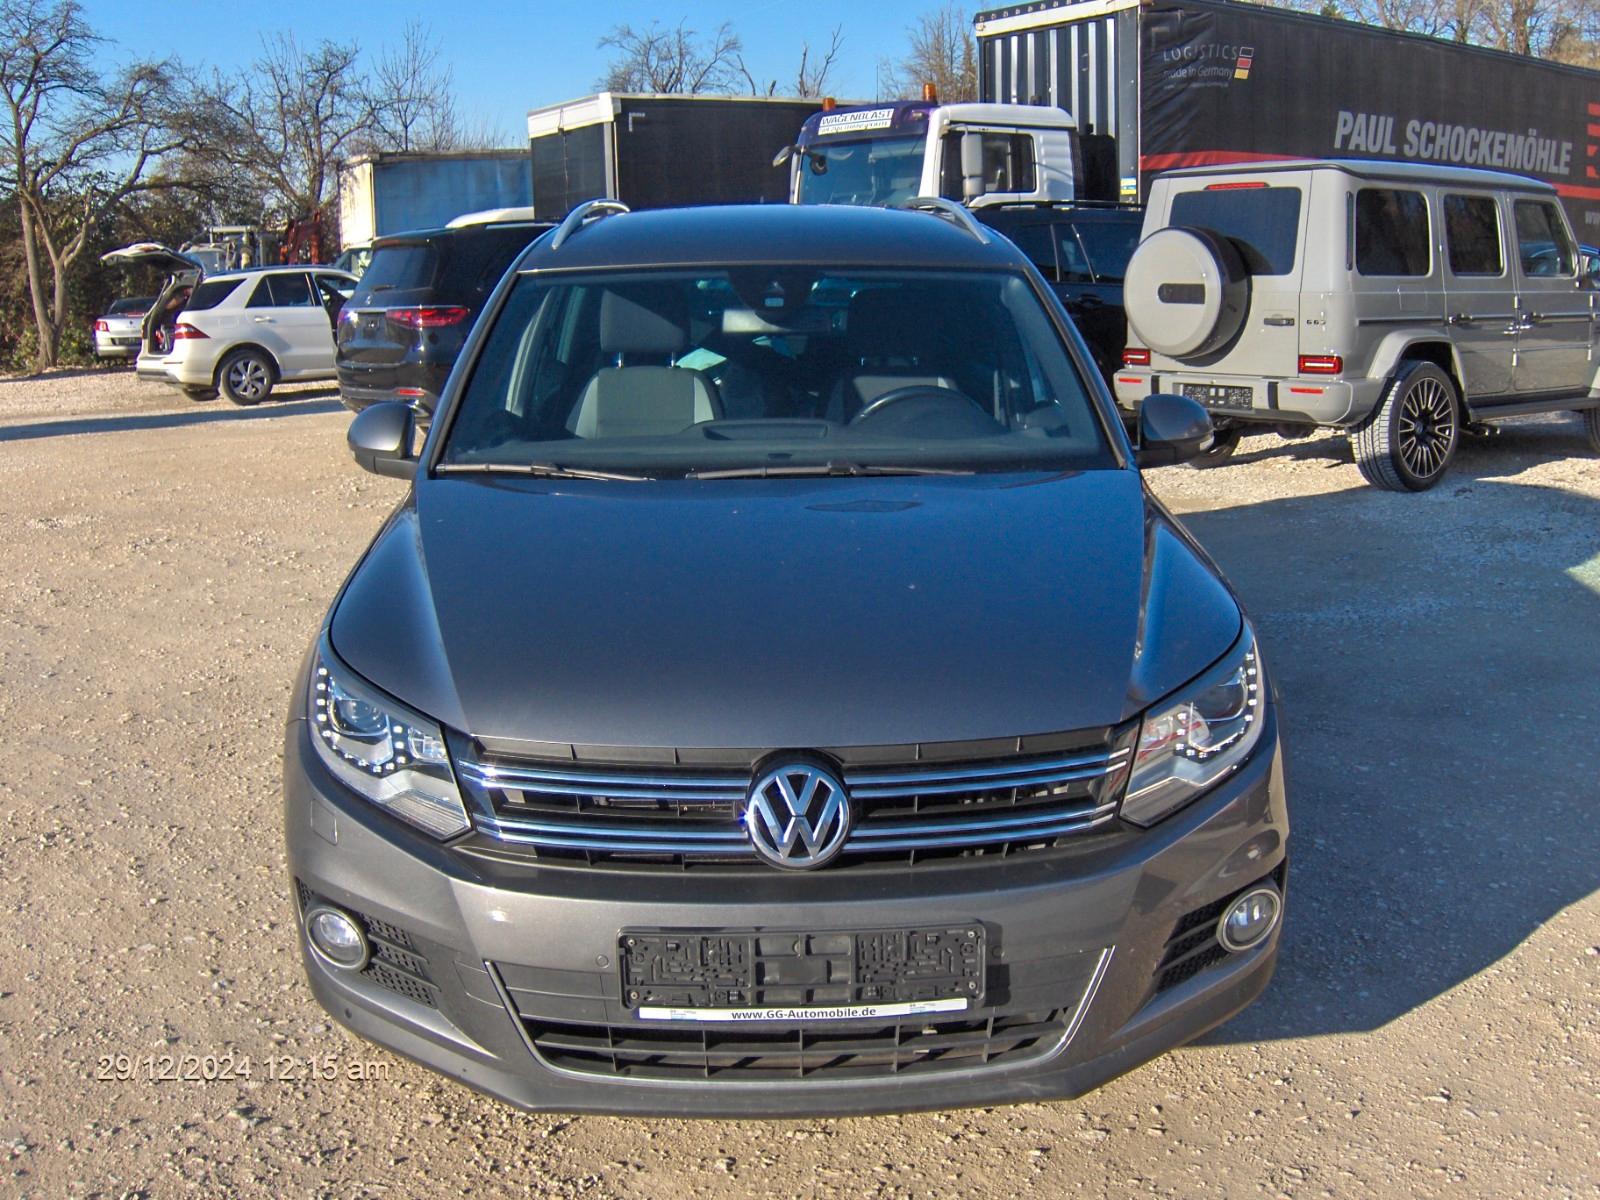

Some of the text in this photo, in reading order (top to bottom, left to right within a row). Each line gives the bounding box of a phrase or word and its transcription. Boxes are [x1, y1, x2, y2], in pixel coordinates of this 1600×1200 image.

[1163, 44, 1238, 62] LOGISTICS
[1188, 66, 1197, 77] in
[1197, 65, 1234, 80] Germany
[1334, 110, 1573, 175] PAUL SCHOCKEMÖHLE
[731, 1007, 877, 1020] www.GG-Automobile.de
